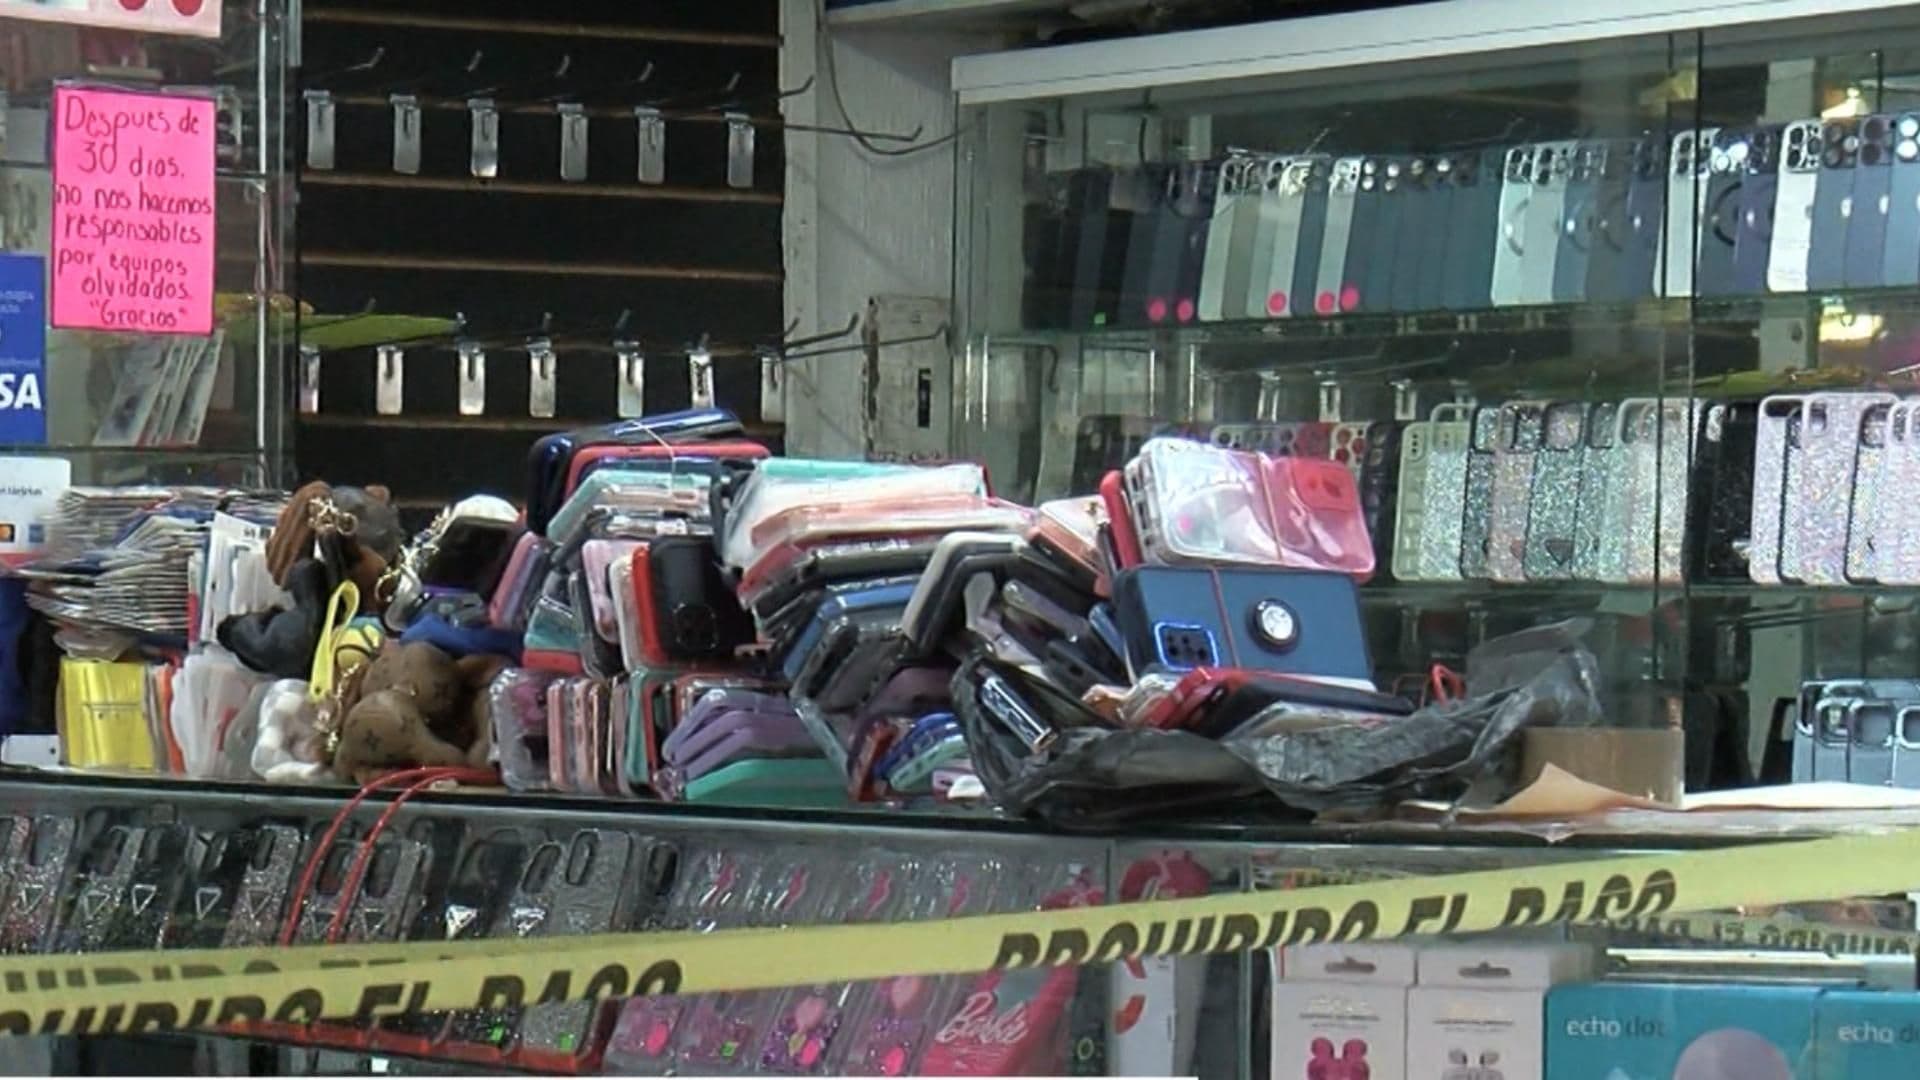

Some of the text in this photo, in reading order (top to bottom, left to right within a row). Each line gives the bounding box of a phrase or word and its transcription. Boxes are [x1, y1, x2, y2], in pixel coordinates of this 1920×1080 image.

[65, 96, 200, 157] Despues de
[78, 140, 117, 174] 30
[56, 184, 82, 206] no
[94, 188, 131, 209] nos
[65, 213, 202, 246] responsables
[58, 248, 187, 282] por equipos
[935, 991, 1030, 1045] Barbie
[1566, 1015, 1665, 1038] echo dot
[1837, 1020, 1894, 1043] echo
